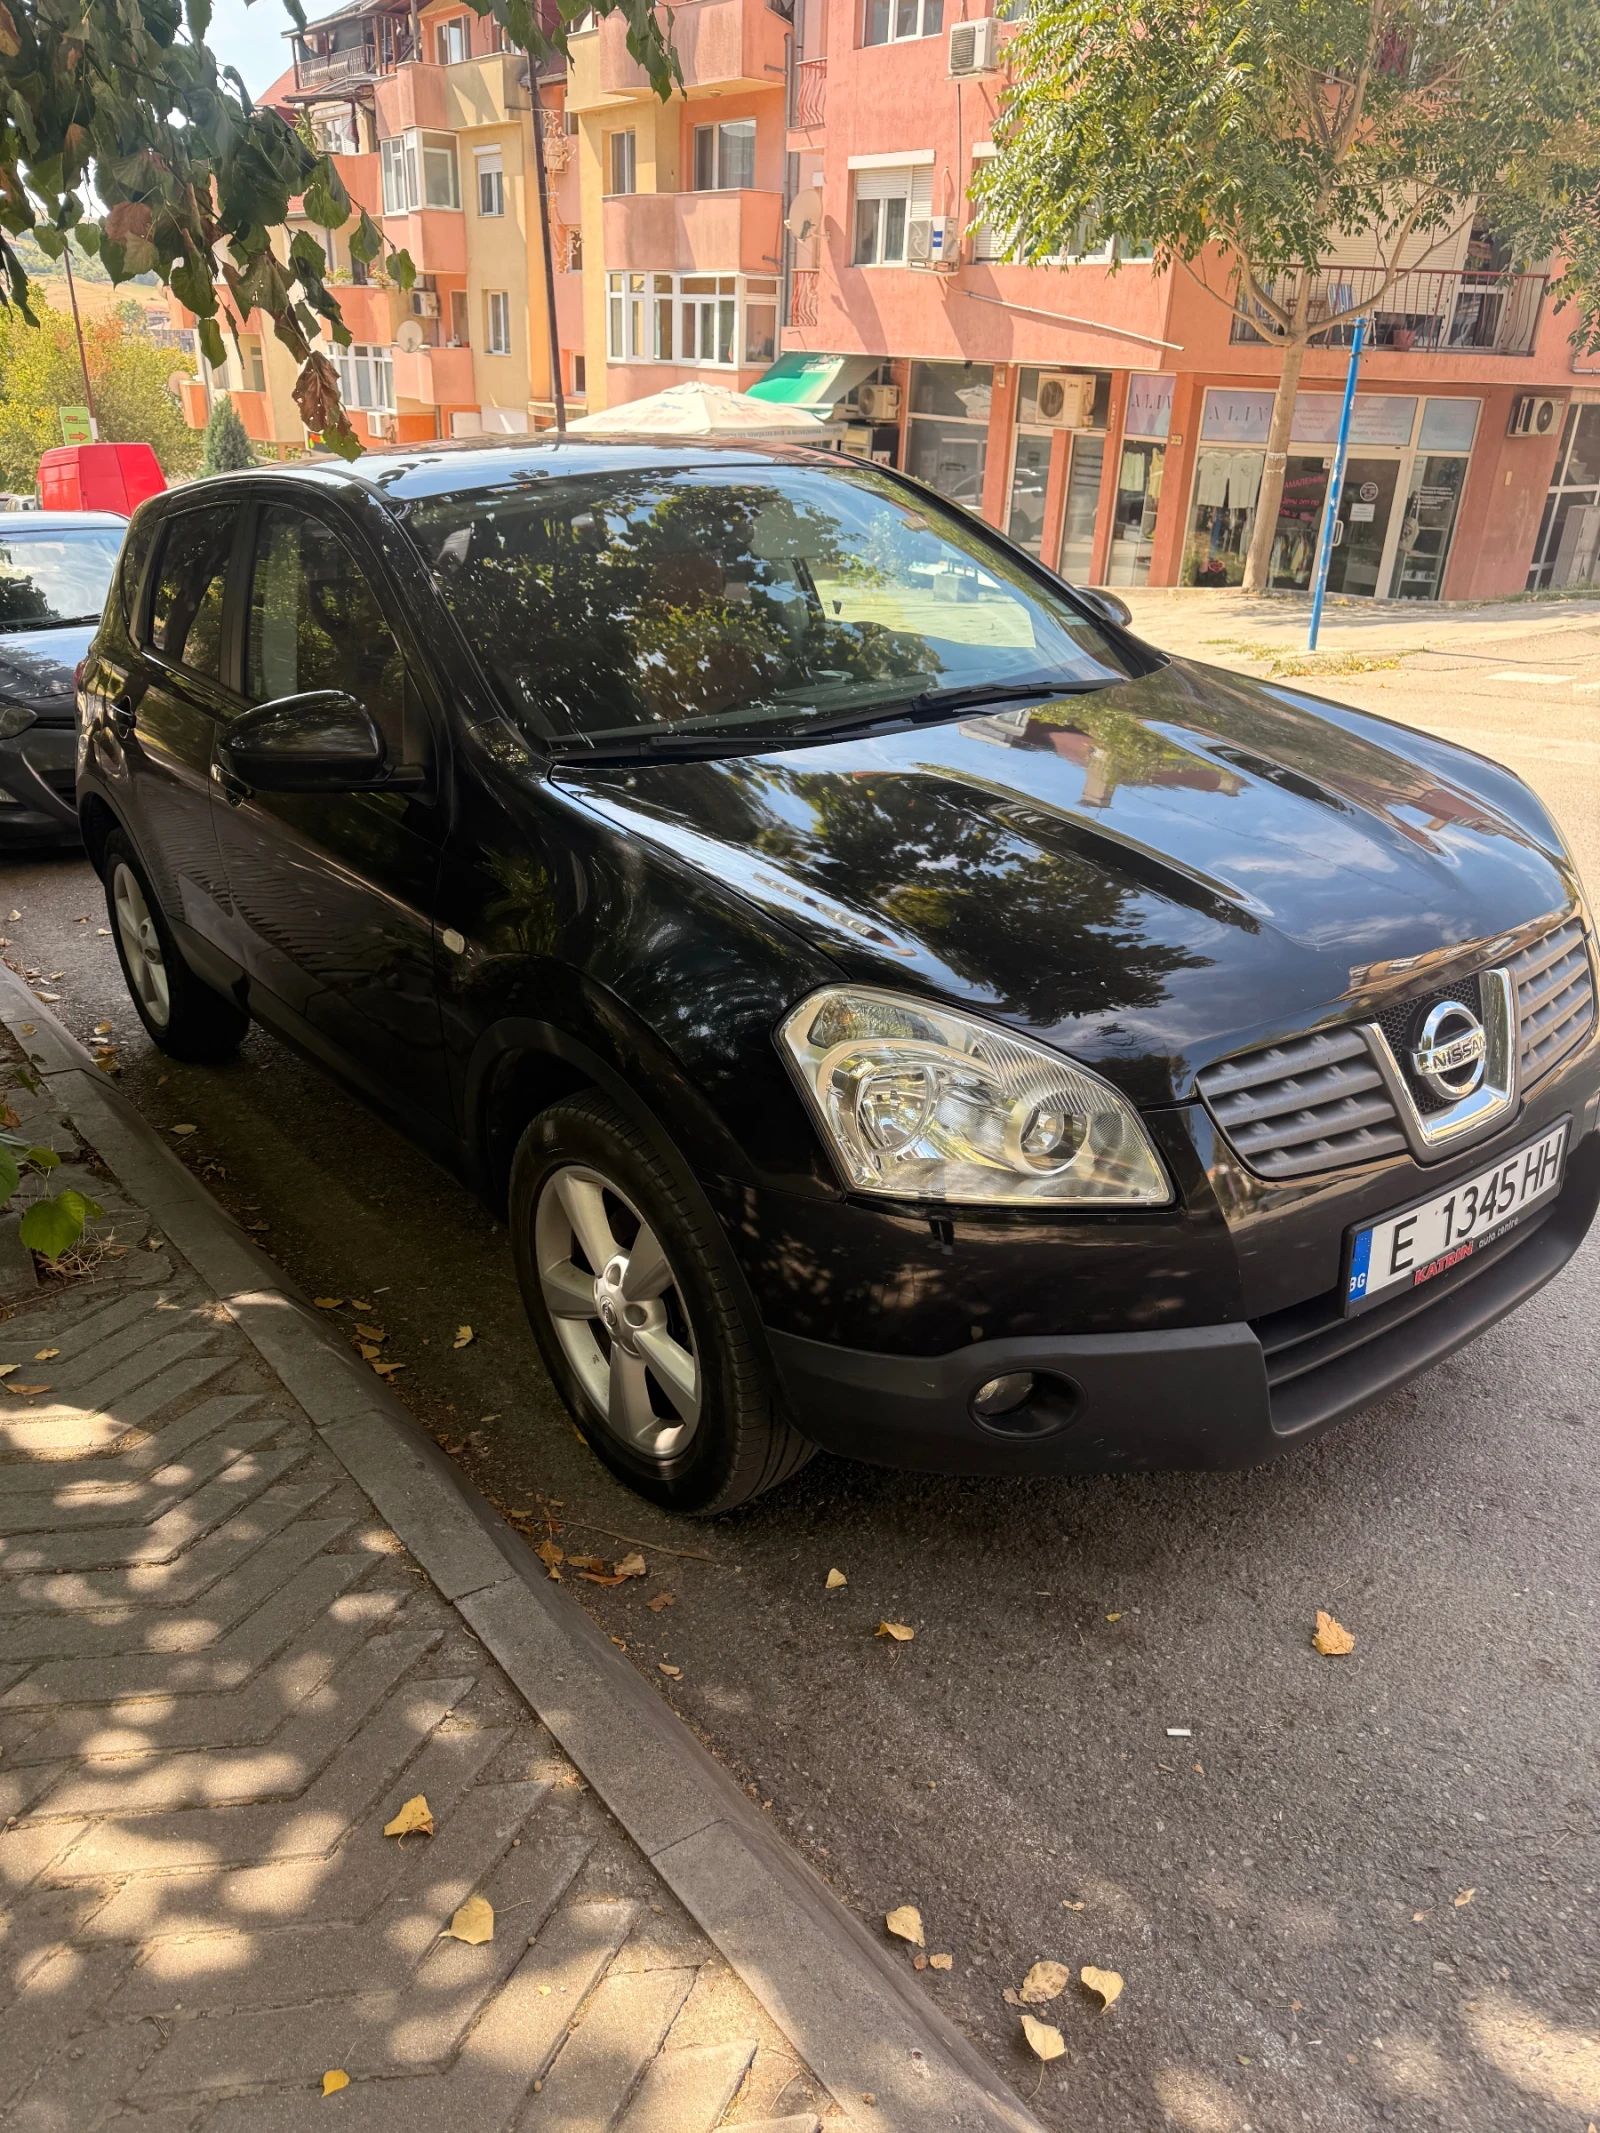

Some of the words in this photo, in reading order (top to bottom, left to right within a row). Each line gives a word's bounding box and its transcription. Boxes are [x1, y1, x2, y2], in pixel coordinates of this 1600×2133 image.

[1284, 475, 1325, 488] АМАЛЕНИЕ
[1432, 1034, 1486, 1069] NISSAN
[1390, 1215, 1418, 1276] E
[1443, 1160, 1519, 1247] 1345
[1520, 1132, 1563, 1202] HH
[1414, 1240, 1474, 1286] KATRIN
[1478, 1232, 1496, 1249] auto
[1497, 1217, 1519, 1237] centre
[1350, 1273, 1366, 1292] BG
